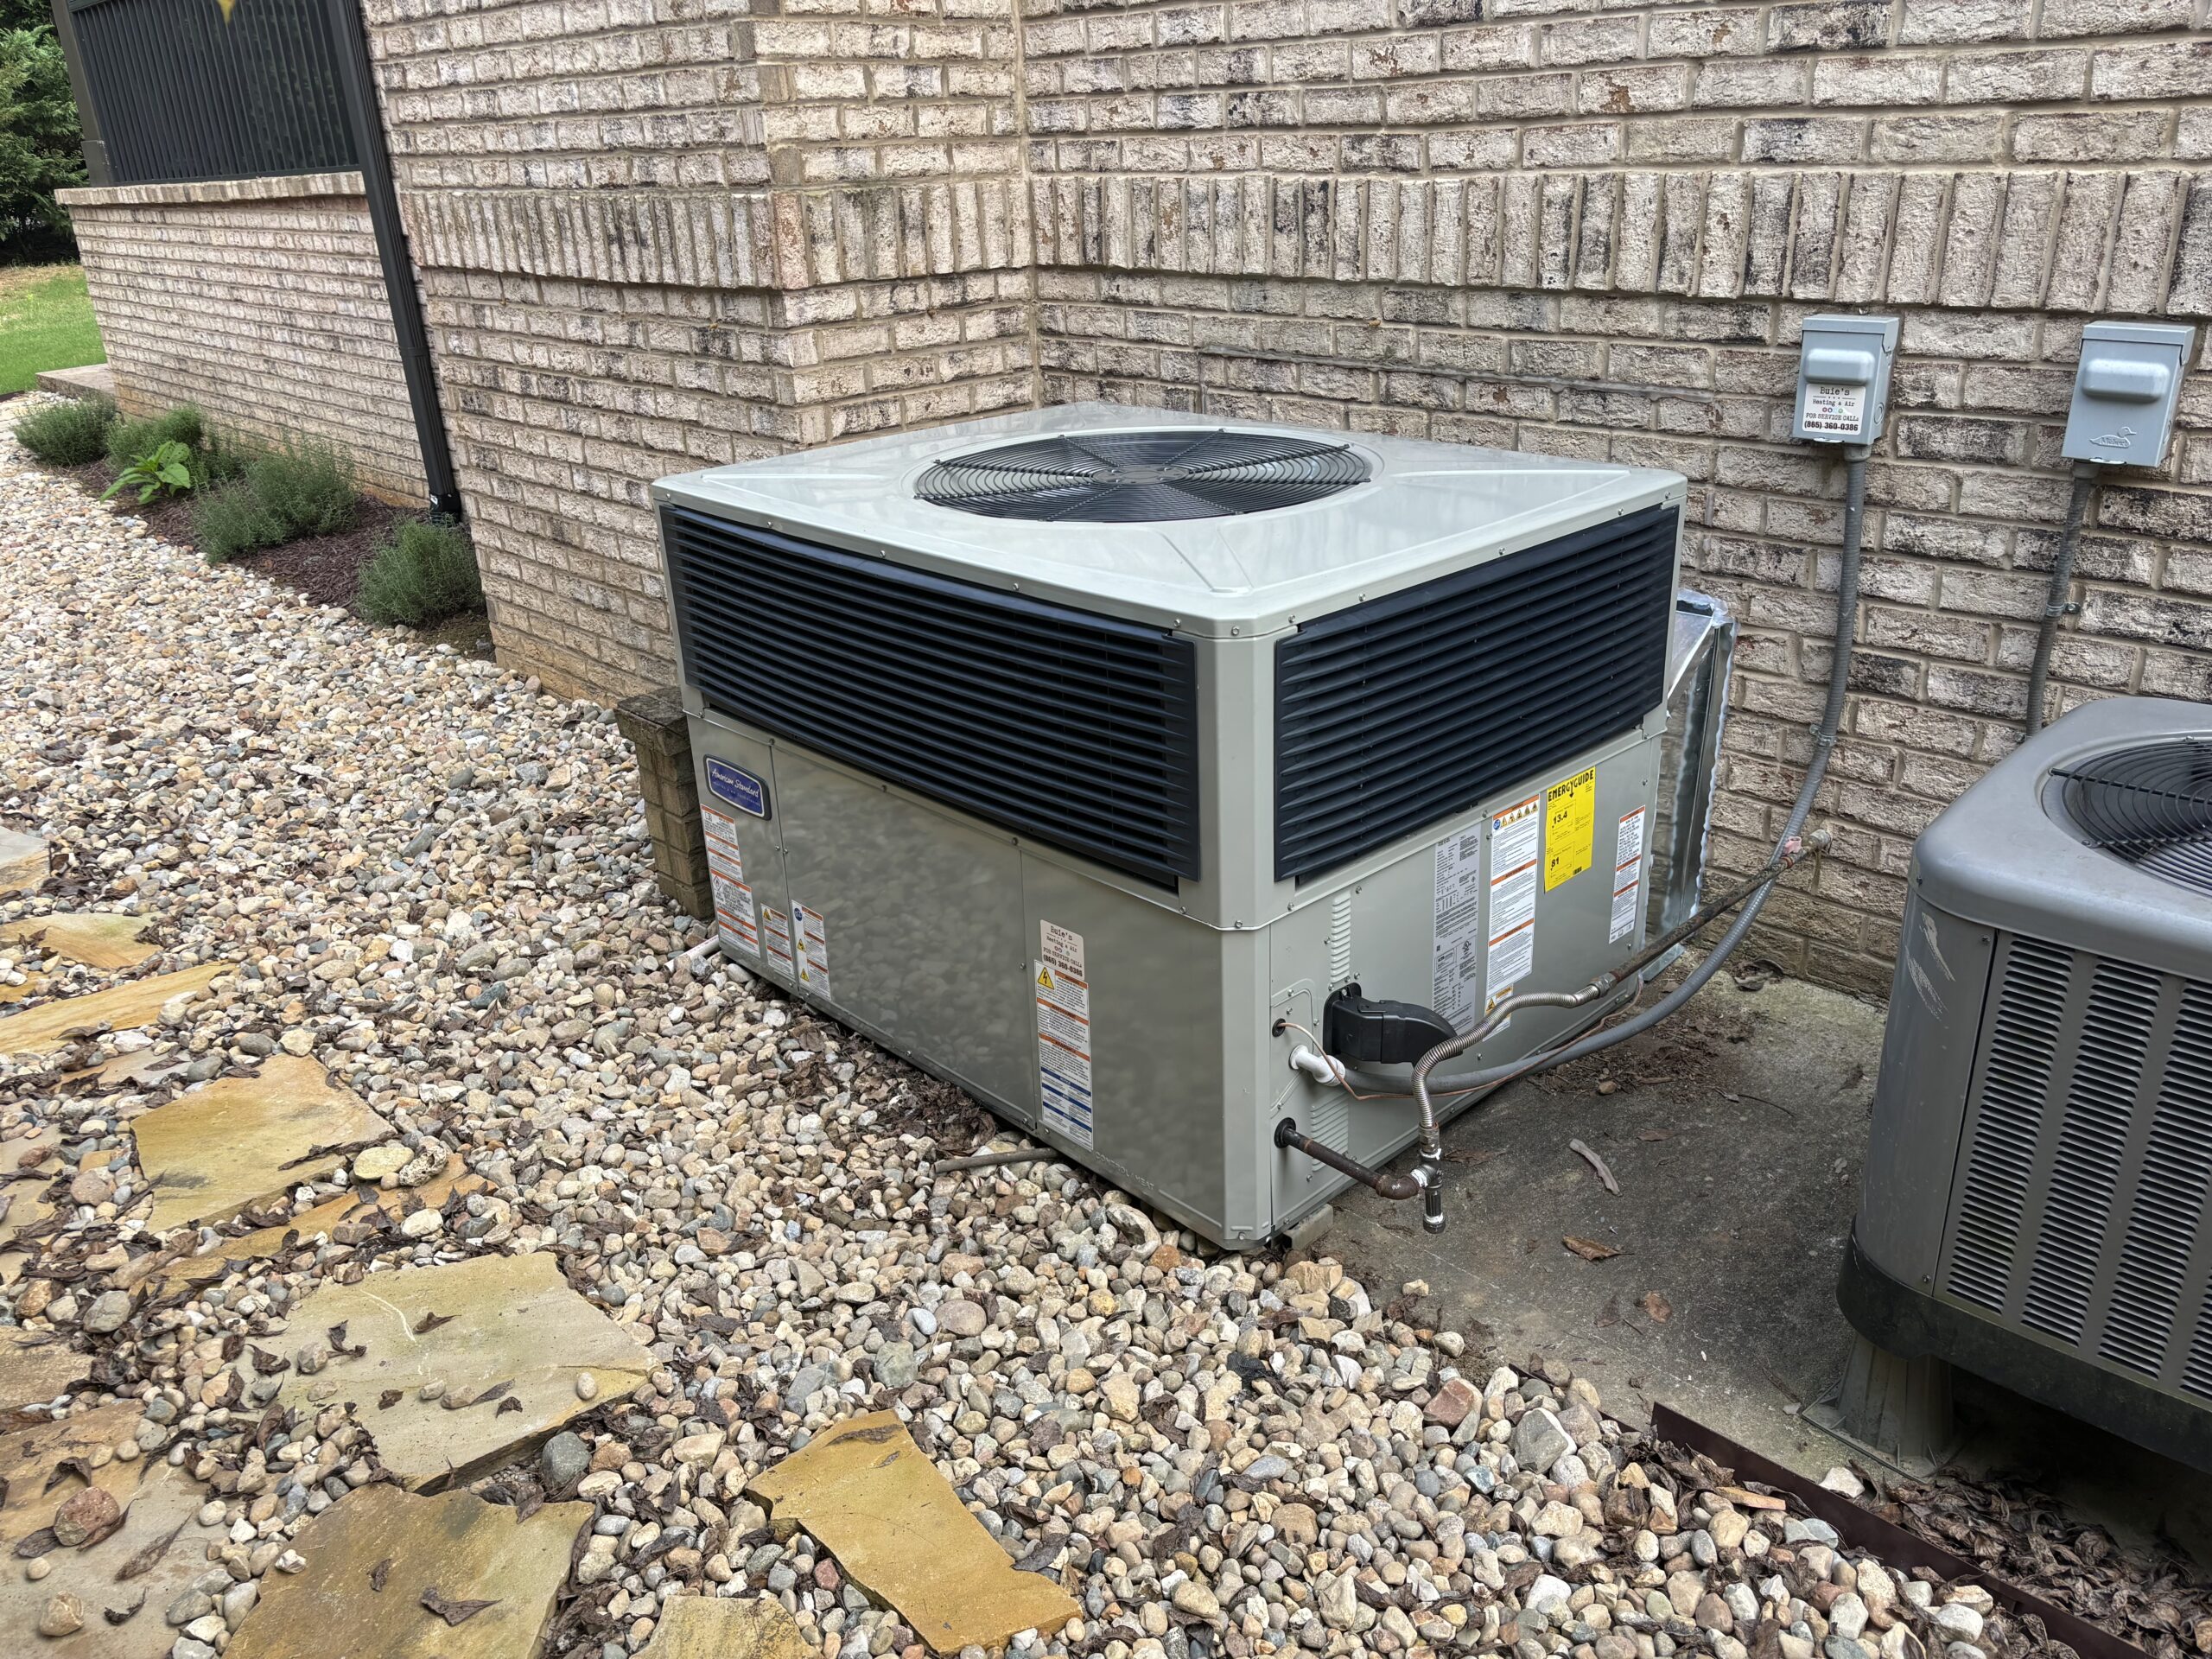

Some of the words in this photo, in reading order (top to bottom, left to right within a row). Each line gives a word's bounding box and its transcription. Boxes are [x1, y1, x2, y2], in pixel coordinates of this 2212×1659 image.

[1825, 422, 1859, 431] 360-0386
[712, 767, 734, 785] American
[734, 779, 760, 798] Standard
[1548, 769, 1594, 802] ENERGYGUIDE
[1553, 813, 1568, 825] 13.4
[1551, 856, 1560, 868] 81
[1051, 925, 1073, 941] Buie's
[1046, 936, 1064, 948] Heating
[1095, 1151, 1129, 1177] CONTROL
[1135, 1174, 1155, 1191] HEAT
